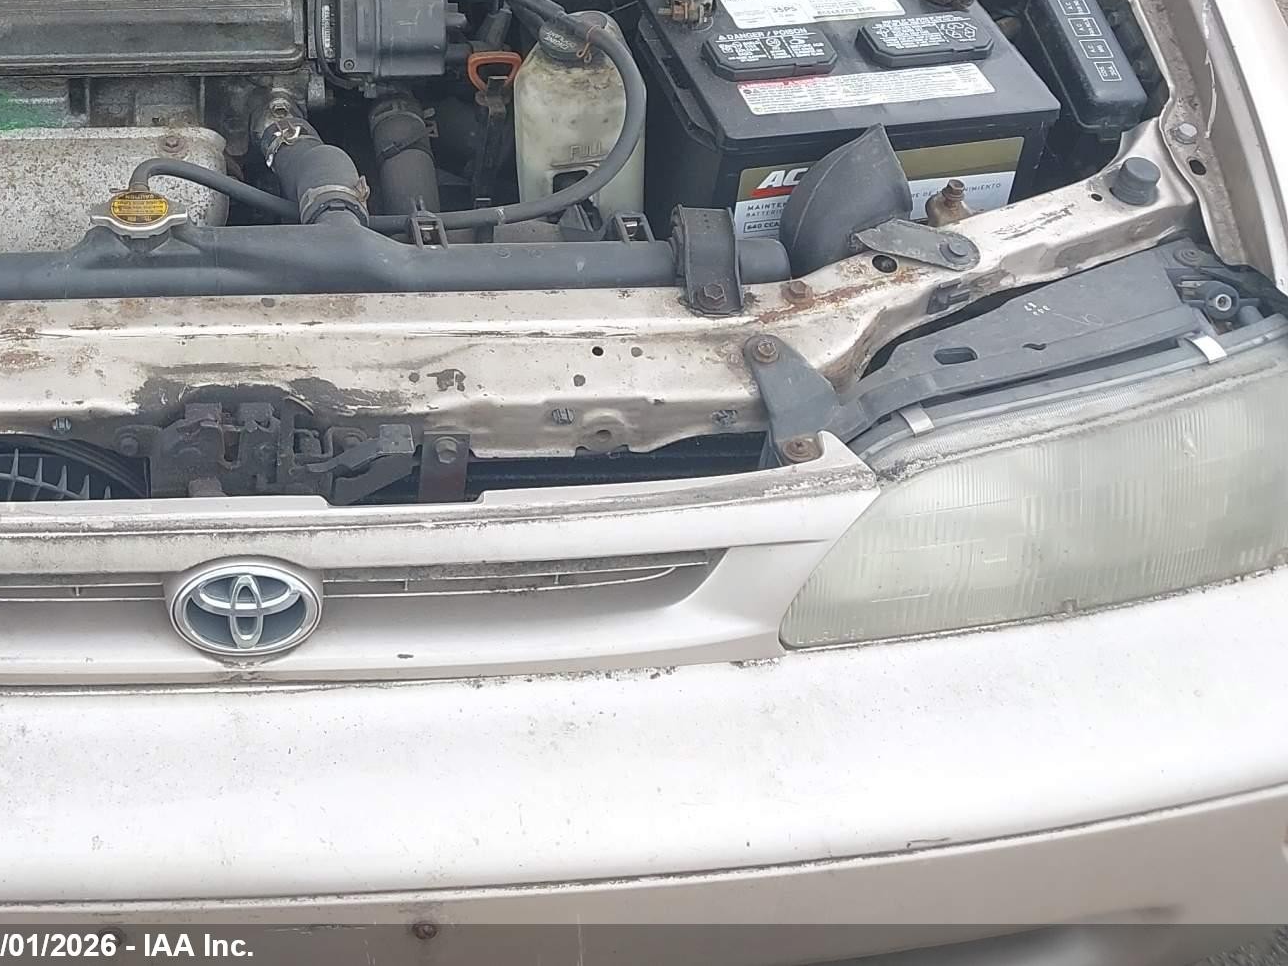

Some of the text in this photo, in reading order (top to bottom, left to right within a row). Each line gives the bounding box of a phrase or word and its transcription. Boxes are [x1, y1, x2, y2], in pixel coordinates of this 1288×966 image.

[726, 31, 764, 40] DANGER
[772, 27, 807, 36] POISON
[756, 167, 809, 189] AC
